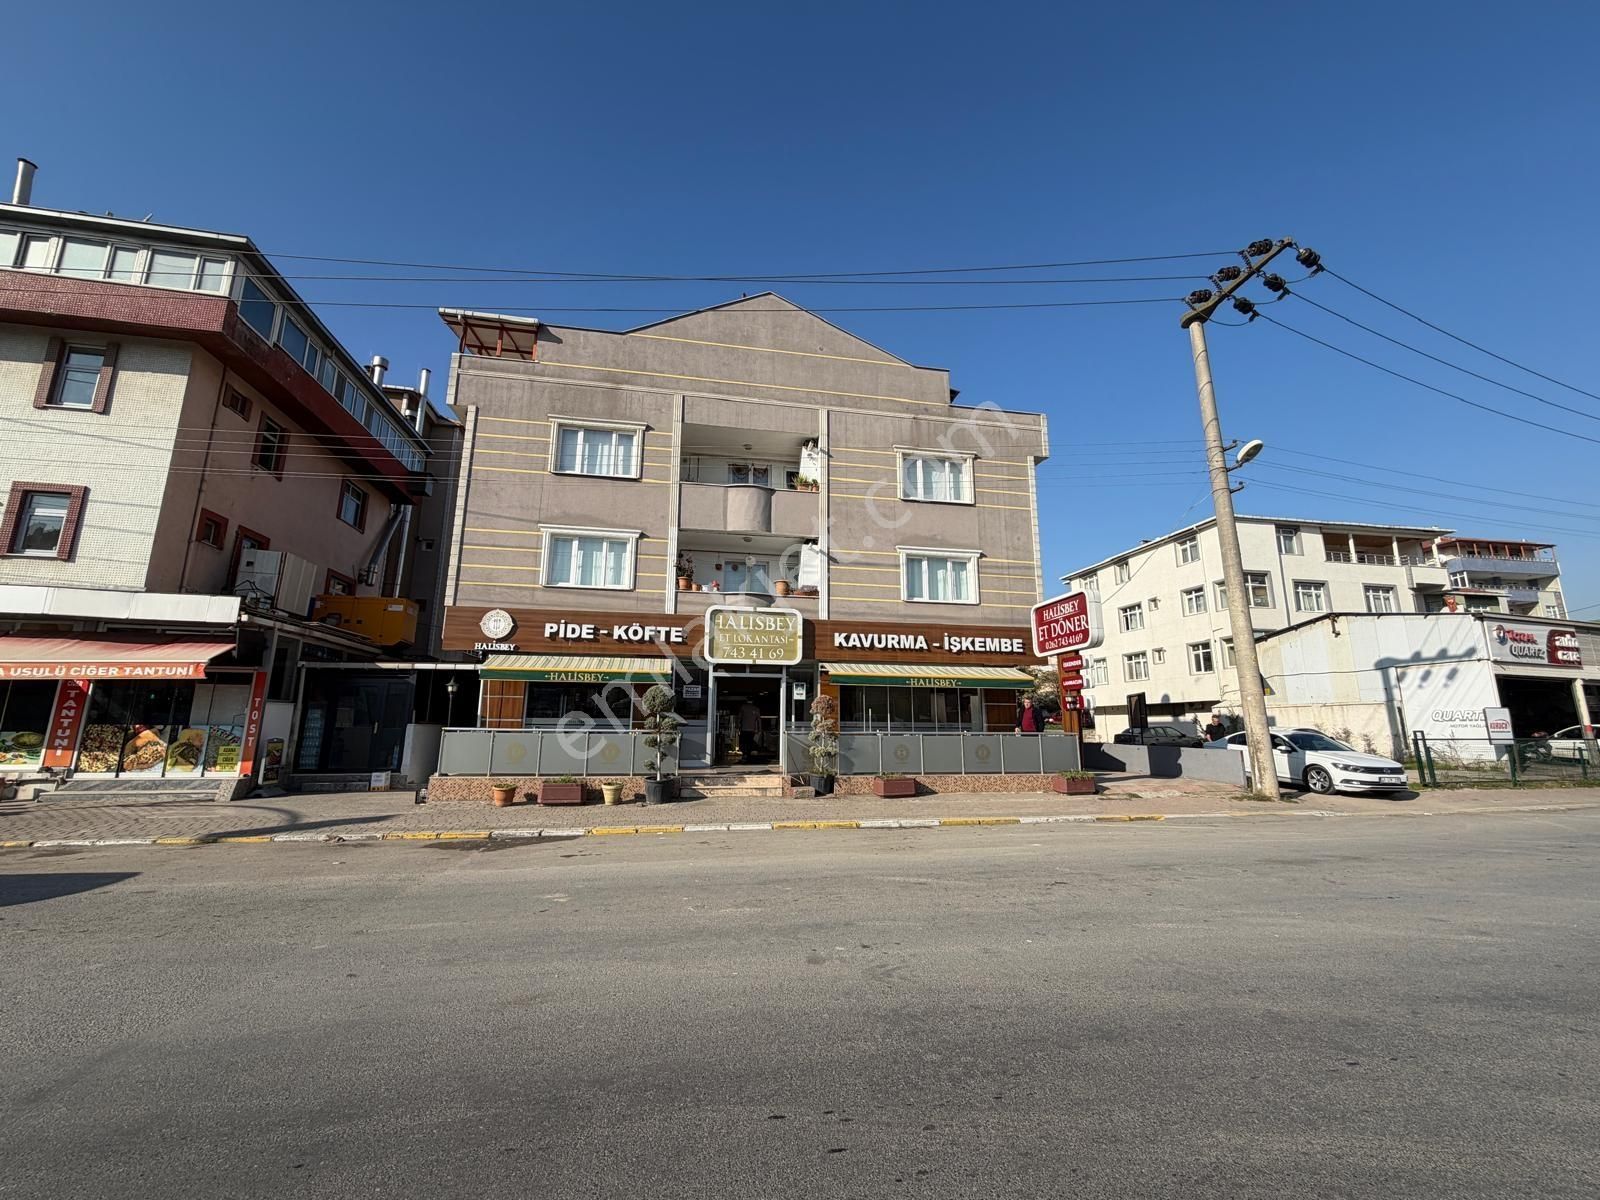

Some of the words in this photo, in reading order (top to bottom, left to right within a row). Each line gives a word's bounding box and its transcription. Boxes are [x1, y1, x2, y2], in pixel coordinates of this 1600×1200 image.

[1043, 599, 1079, 621] HALİSBEY
[544, 619, 595, 639] PİDE
[612, 623, 683, 643] KÖFTE
[1038, 625, 1049, 642] ET
[1051, 615, 1089, 638] DÖNER
[474, 640, 516, 651] HALİSBEY
[834, 632, 929, 651] KAVURMA
[944, 633, 1024, 654] İŞKEMBE
[1511, 644, 1545, 657] QUARTZ
[722, 646, 746, 659] 743
[749, 648, 764, 659] 41
[768, 648, 784, 660] 69
[9, 665, 66, 676] USULÜ
[70, 665, 119, 676] CİĞER
[123, 665, 194, 676] TANTUNİ
[550, 671, 604, 682] HALİSBEY
[909, 678, 958, 687] HALİSBEY
[53, 690, 80, 757] TANTUNİ
[247, 697, 261, 747] TOST
